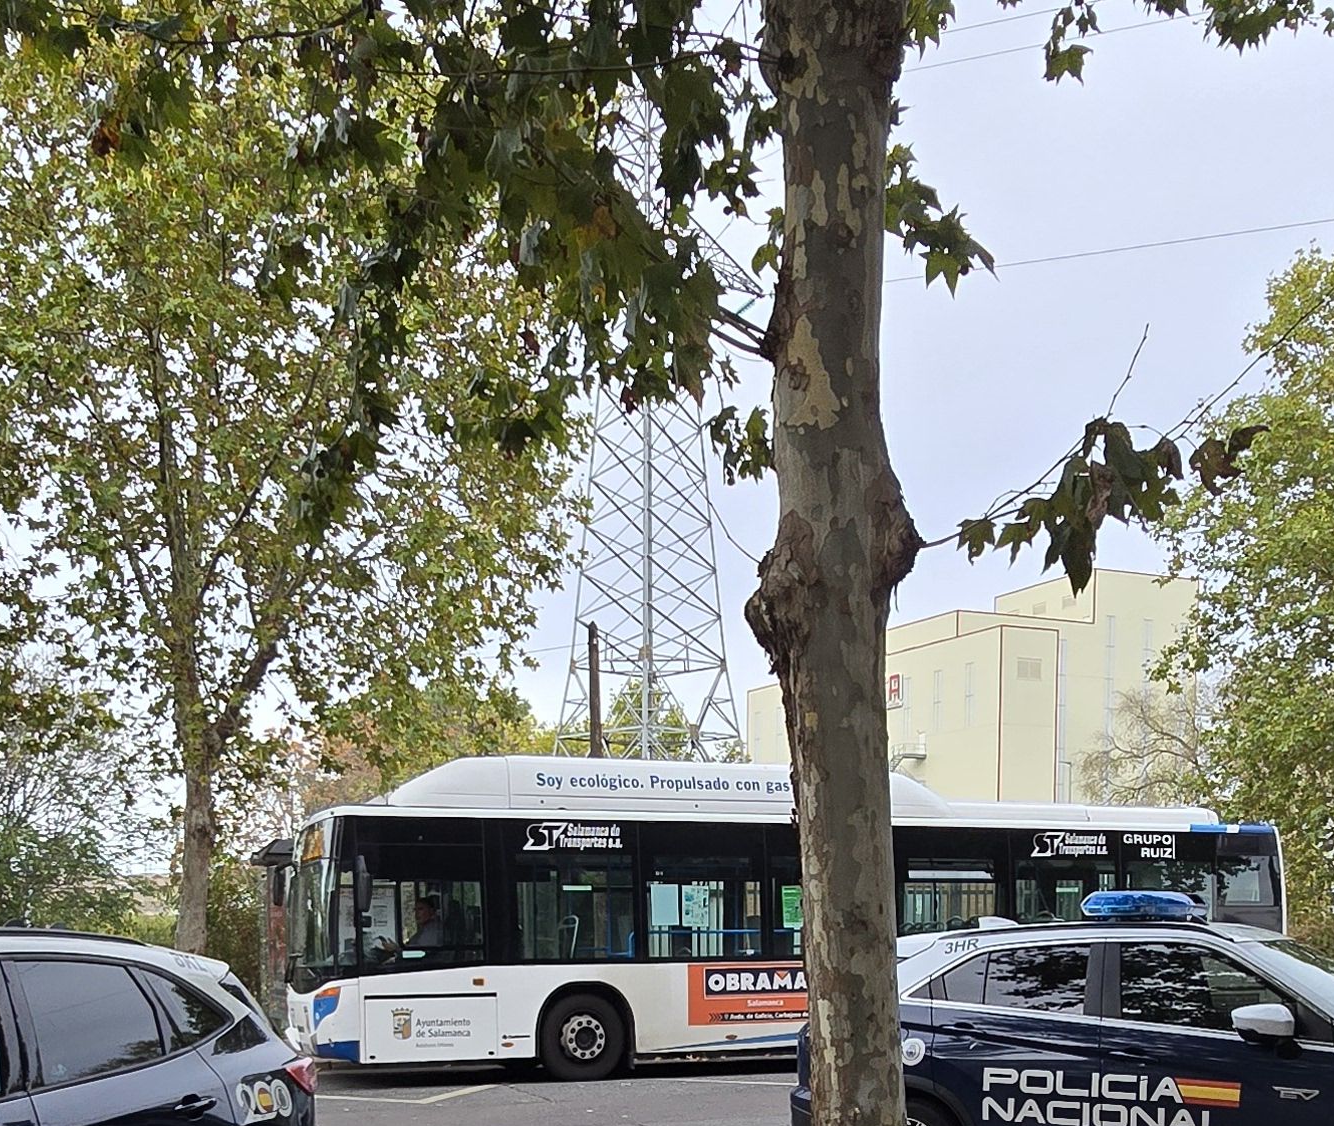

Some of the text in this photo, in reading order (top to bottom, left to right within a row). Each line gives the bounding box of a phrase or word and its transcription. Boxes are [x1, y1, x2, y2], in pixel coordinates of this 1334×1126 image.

[536, 772, 790, 794] Soy ecológico. Propulsado con gas
[567, 823, 609, 836] Salamanca
[559, 834, 607, 850] Transportes
[1123, 833, 1172, 845] GRUPO
[1141, 847, 1173, 858] RUIZ
[944, 938, 979, 954] 3HR
[415, 1018, 471, 1029] Ayuntamiento
[416, 1028, 471, 1038] de Salamanca
